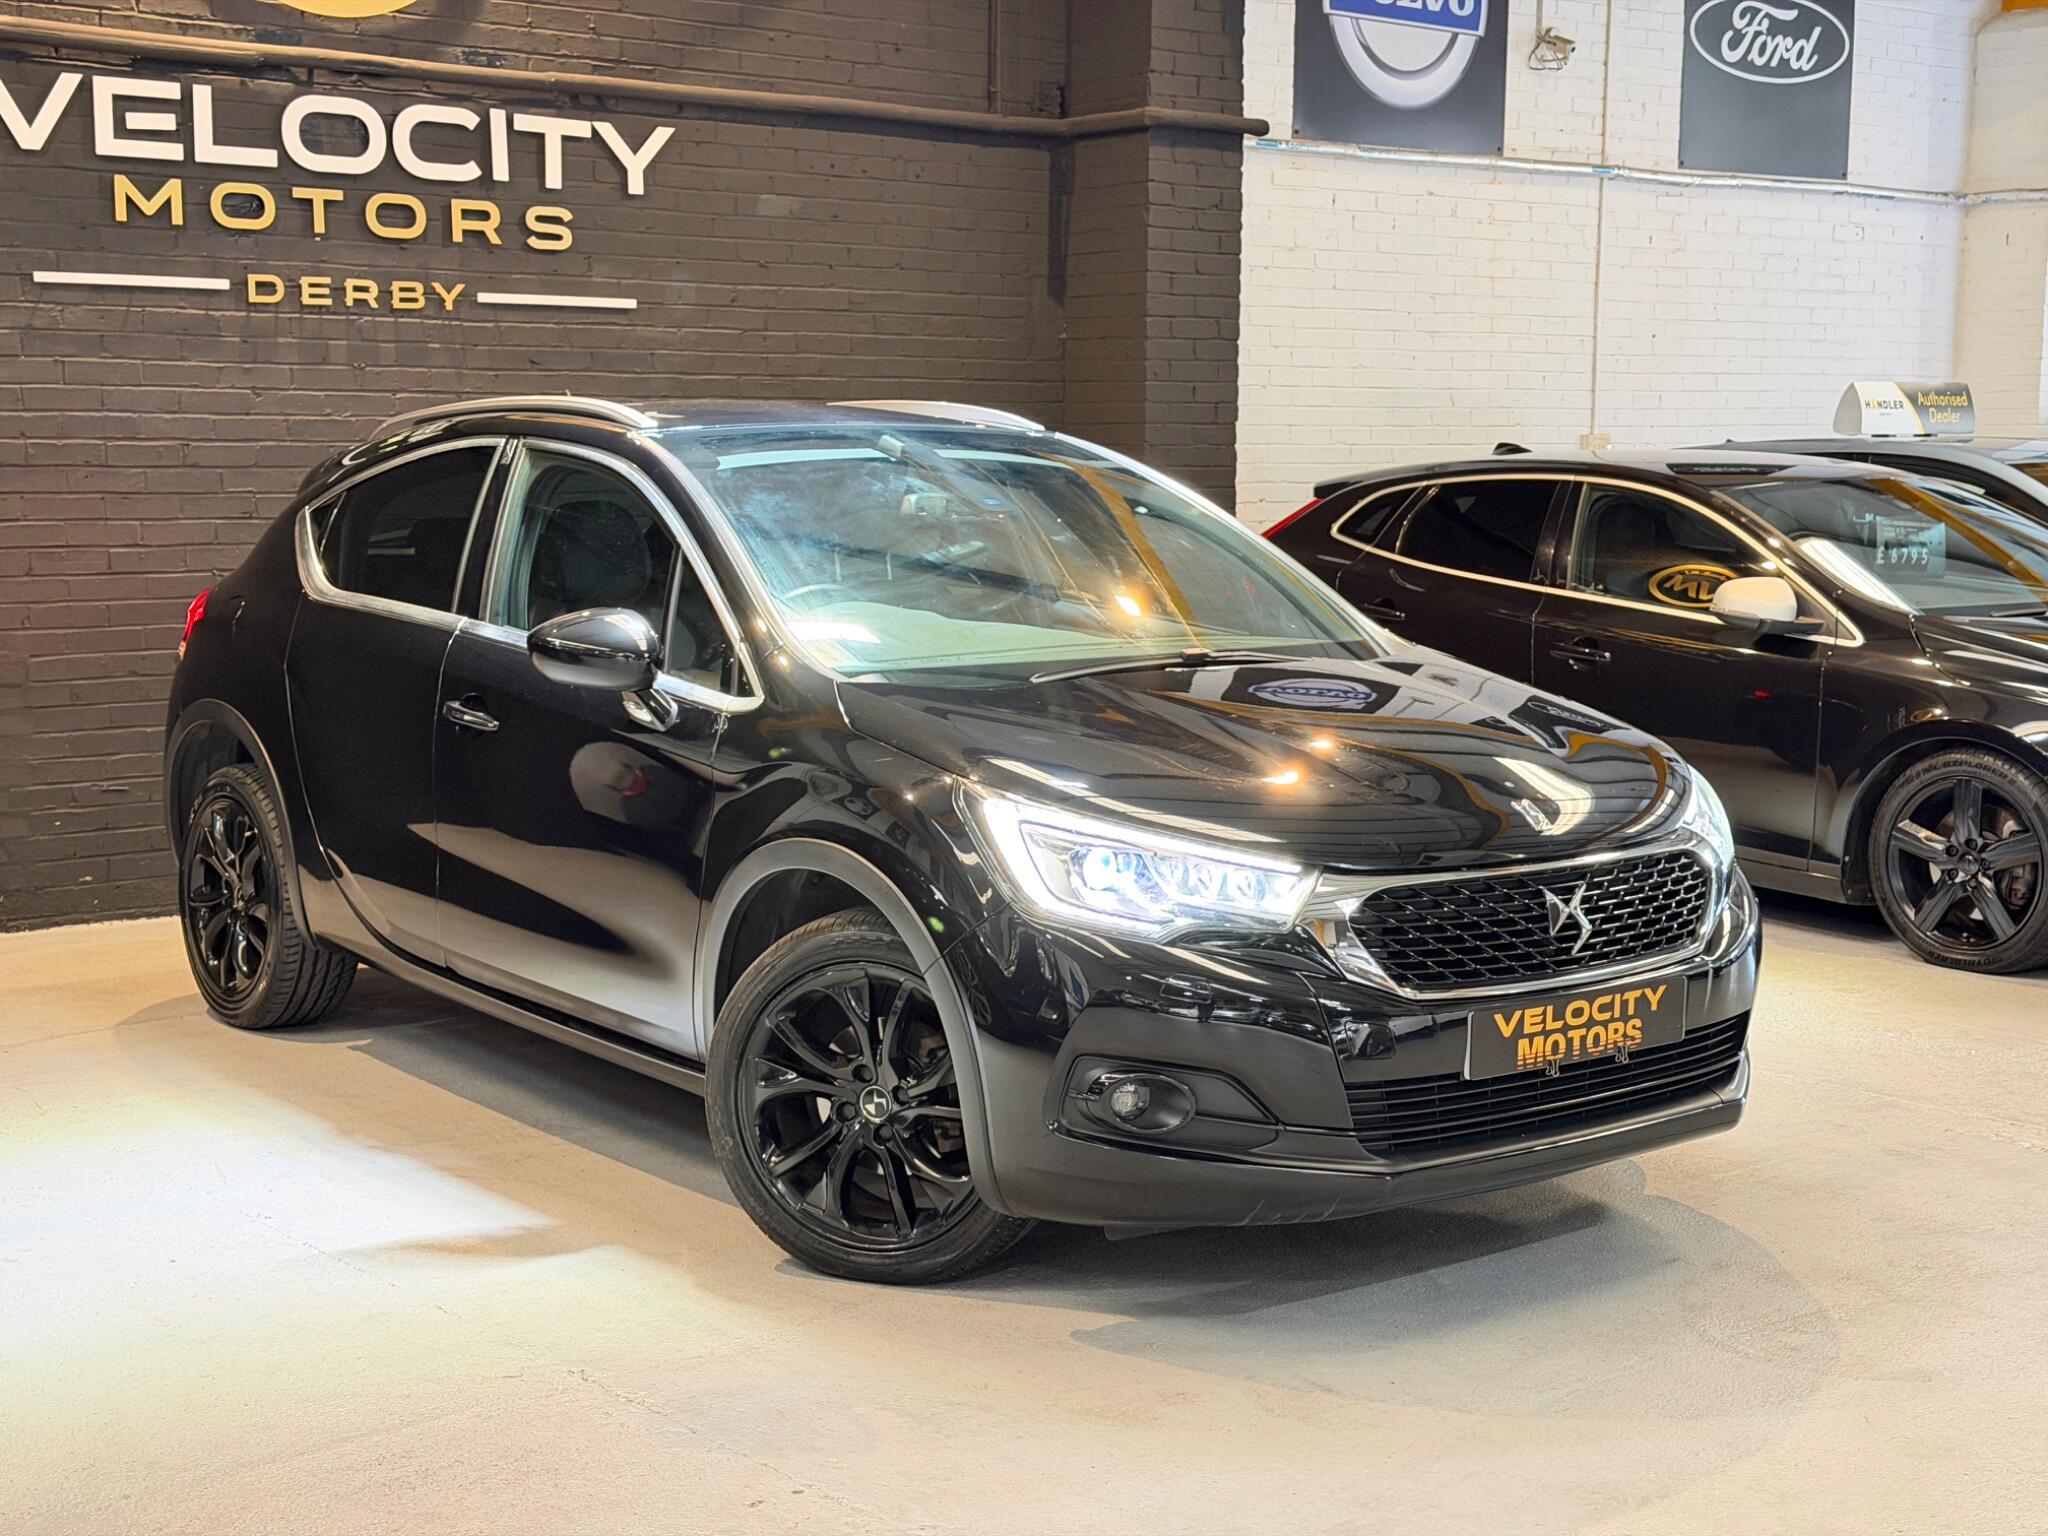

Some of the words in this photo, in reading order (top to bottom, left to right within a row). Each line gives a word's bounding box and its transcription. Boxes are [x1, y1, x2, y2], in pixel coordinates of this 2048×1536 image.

[1721, 1, 1822, 71] Ford
[0, 72, 675, 195] VELOCITY
[113, 174, 574, 251] MOTORS
[247, 273, 467, 311] DERBY
[1918, 391, 1968, 406] Authorised
[1929, 407, 1960, 422] Dealer
[1493, 984, 1667, 1038] VELOCITY
[1516, 1018, 1642, 1070] MOTORS
